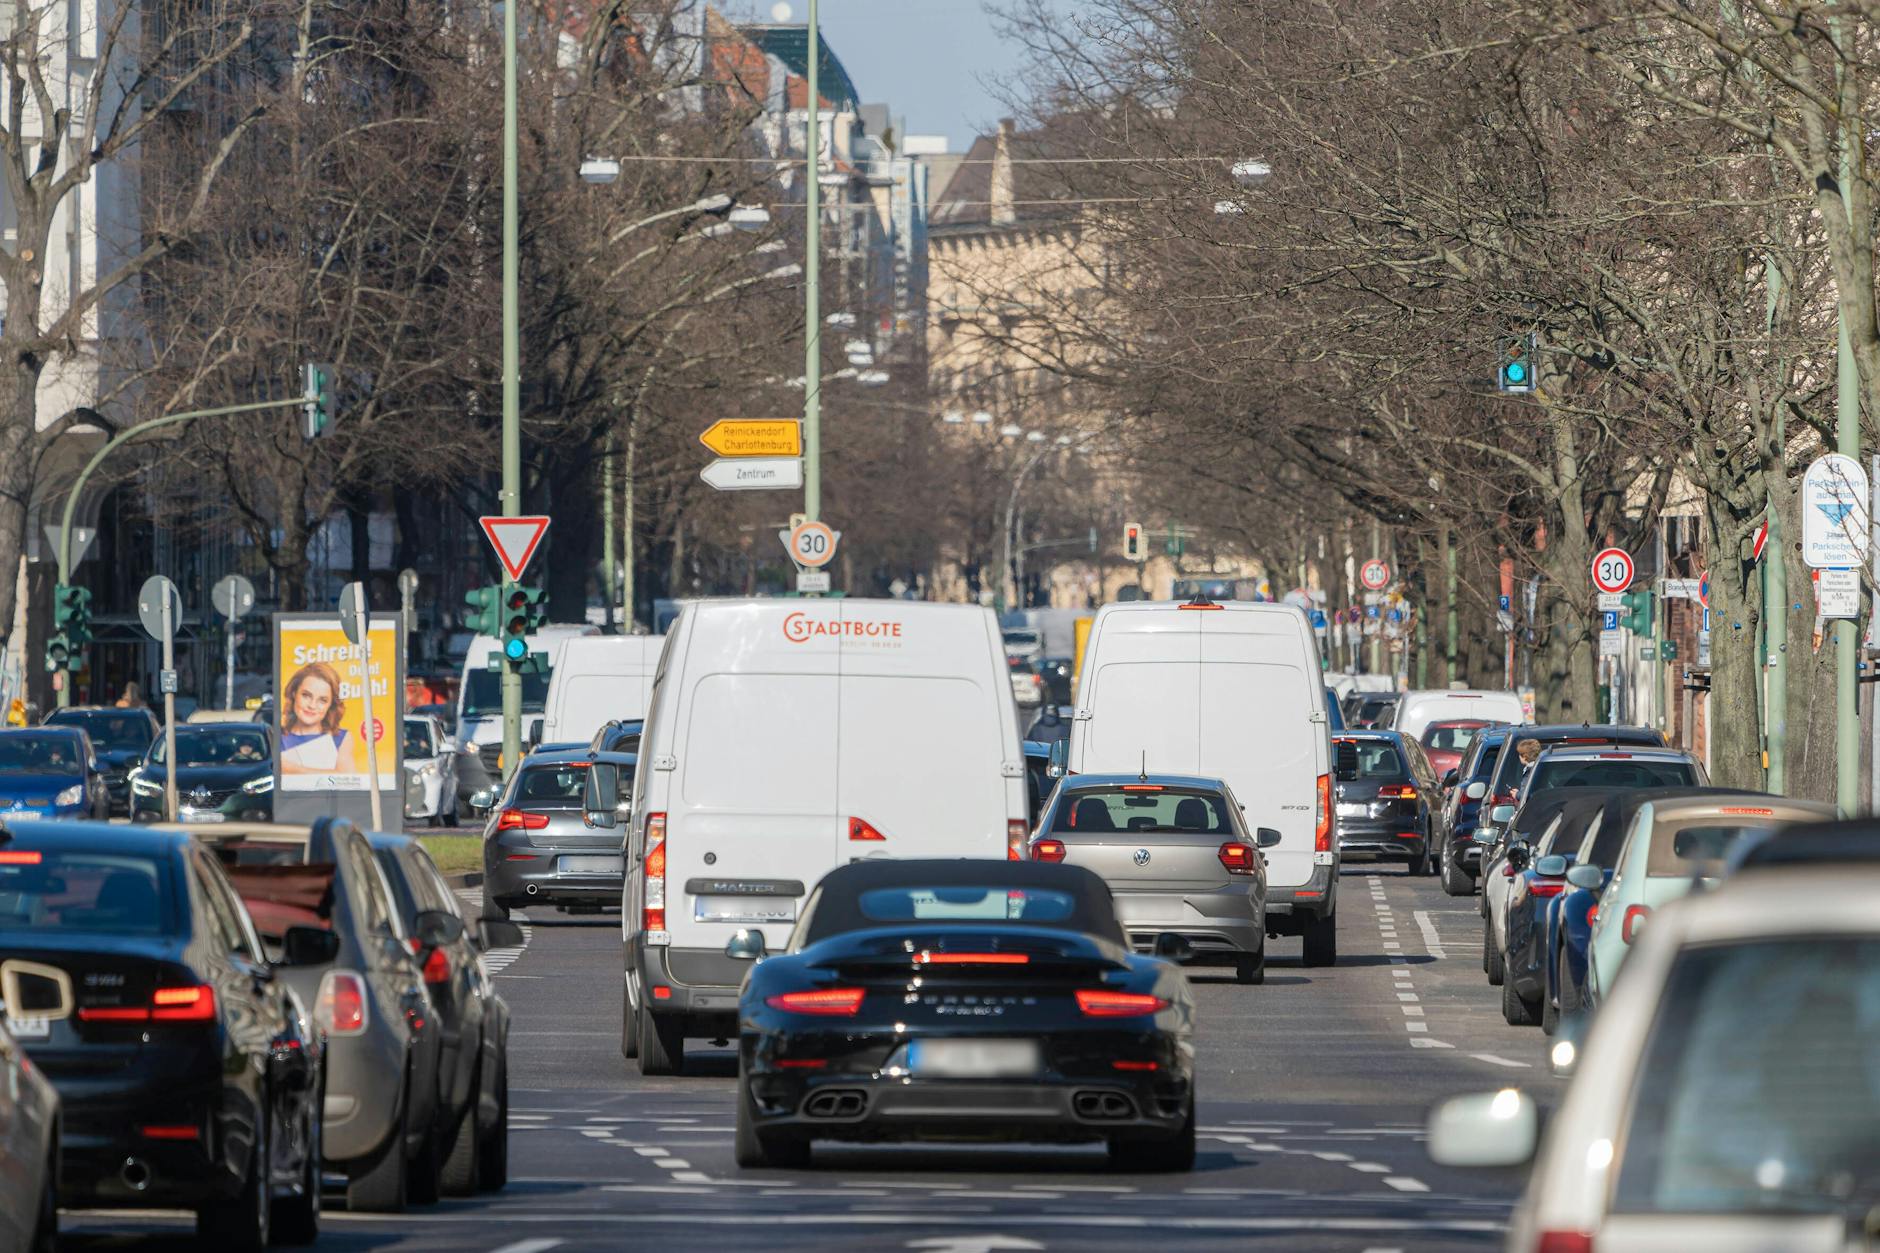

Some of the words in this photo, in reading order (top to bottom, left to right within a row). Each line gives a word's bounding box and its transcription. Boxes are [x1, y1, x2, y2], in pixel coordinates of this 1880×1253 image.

[723, 426, 786, 437] Reinickendorf
[724, 439, 792, 452] Charlottenburg
[736, 468, 776, 480] Zentrum
[800, 534, 825, 553] 30
[1812, 542, 1860, 551] Parkschei
[1824, 551, 1847, 560] lösen
[1601, 562, 1624, 581] 30
[790, 617, 902, 639] STADTBOTE
[349, 663, 380, 676] Dn!
[339, 677, 387, 700] Buh!
[713, 882, 775, 893] MASTER
